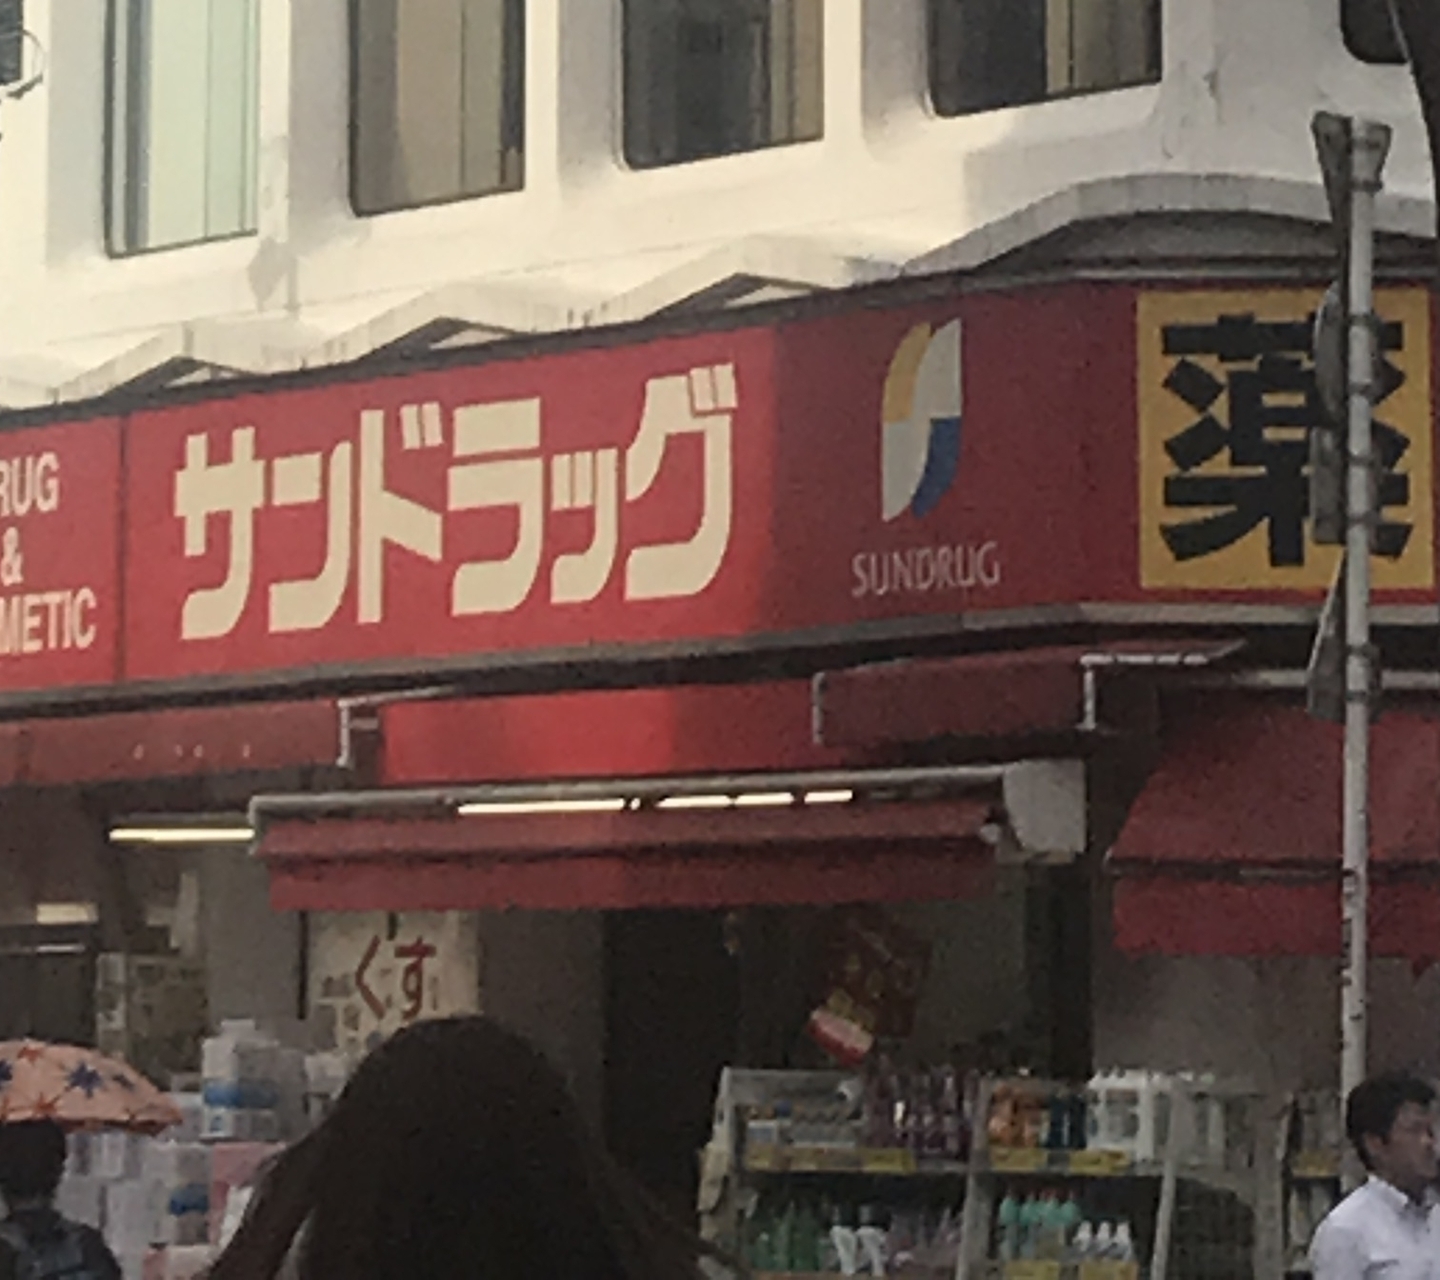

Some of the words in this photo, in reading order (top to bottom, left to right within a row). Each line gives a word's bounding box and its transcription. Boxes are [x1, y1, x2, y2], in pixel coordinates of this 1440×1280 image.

[174, 362, 738, 639] サンドラッグ
[1159, 312, 1414, 568] 薬
[0, 526, 24, 586] &
[850, 540, 1001, 599] SUNDRUG
